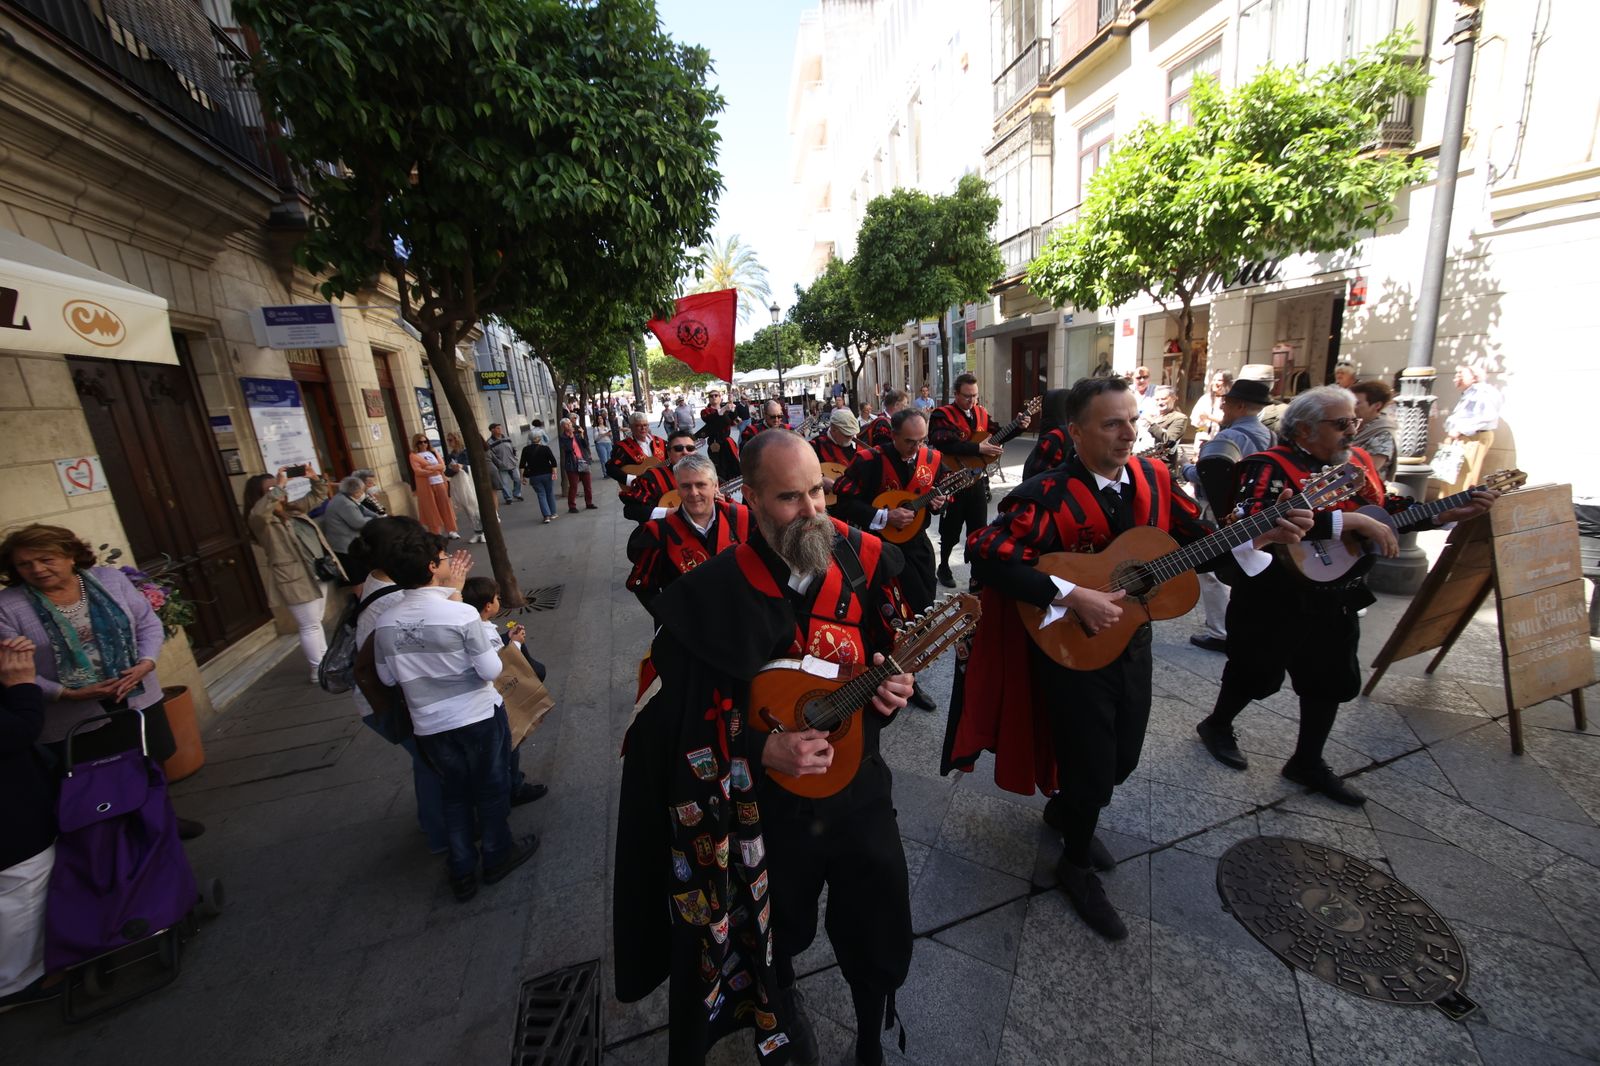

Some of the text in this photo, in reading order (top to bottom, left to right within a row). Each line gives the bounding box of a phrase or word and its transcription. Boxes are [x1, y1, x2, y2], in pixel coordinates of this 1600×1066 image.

[1534, 592, 1557, 614] ICED
[1518, 606, 1579, 638] MILK SHAKES
[1342, 917, 1416, 968] ALCANTARILLADO
